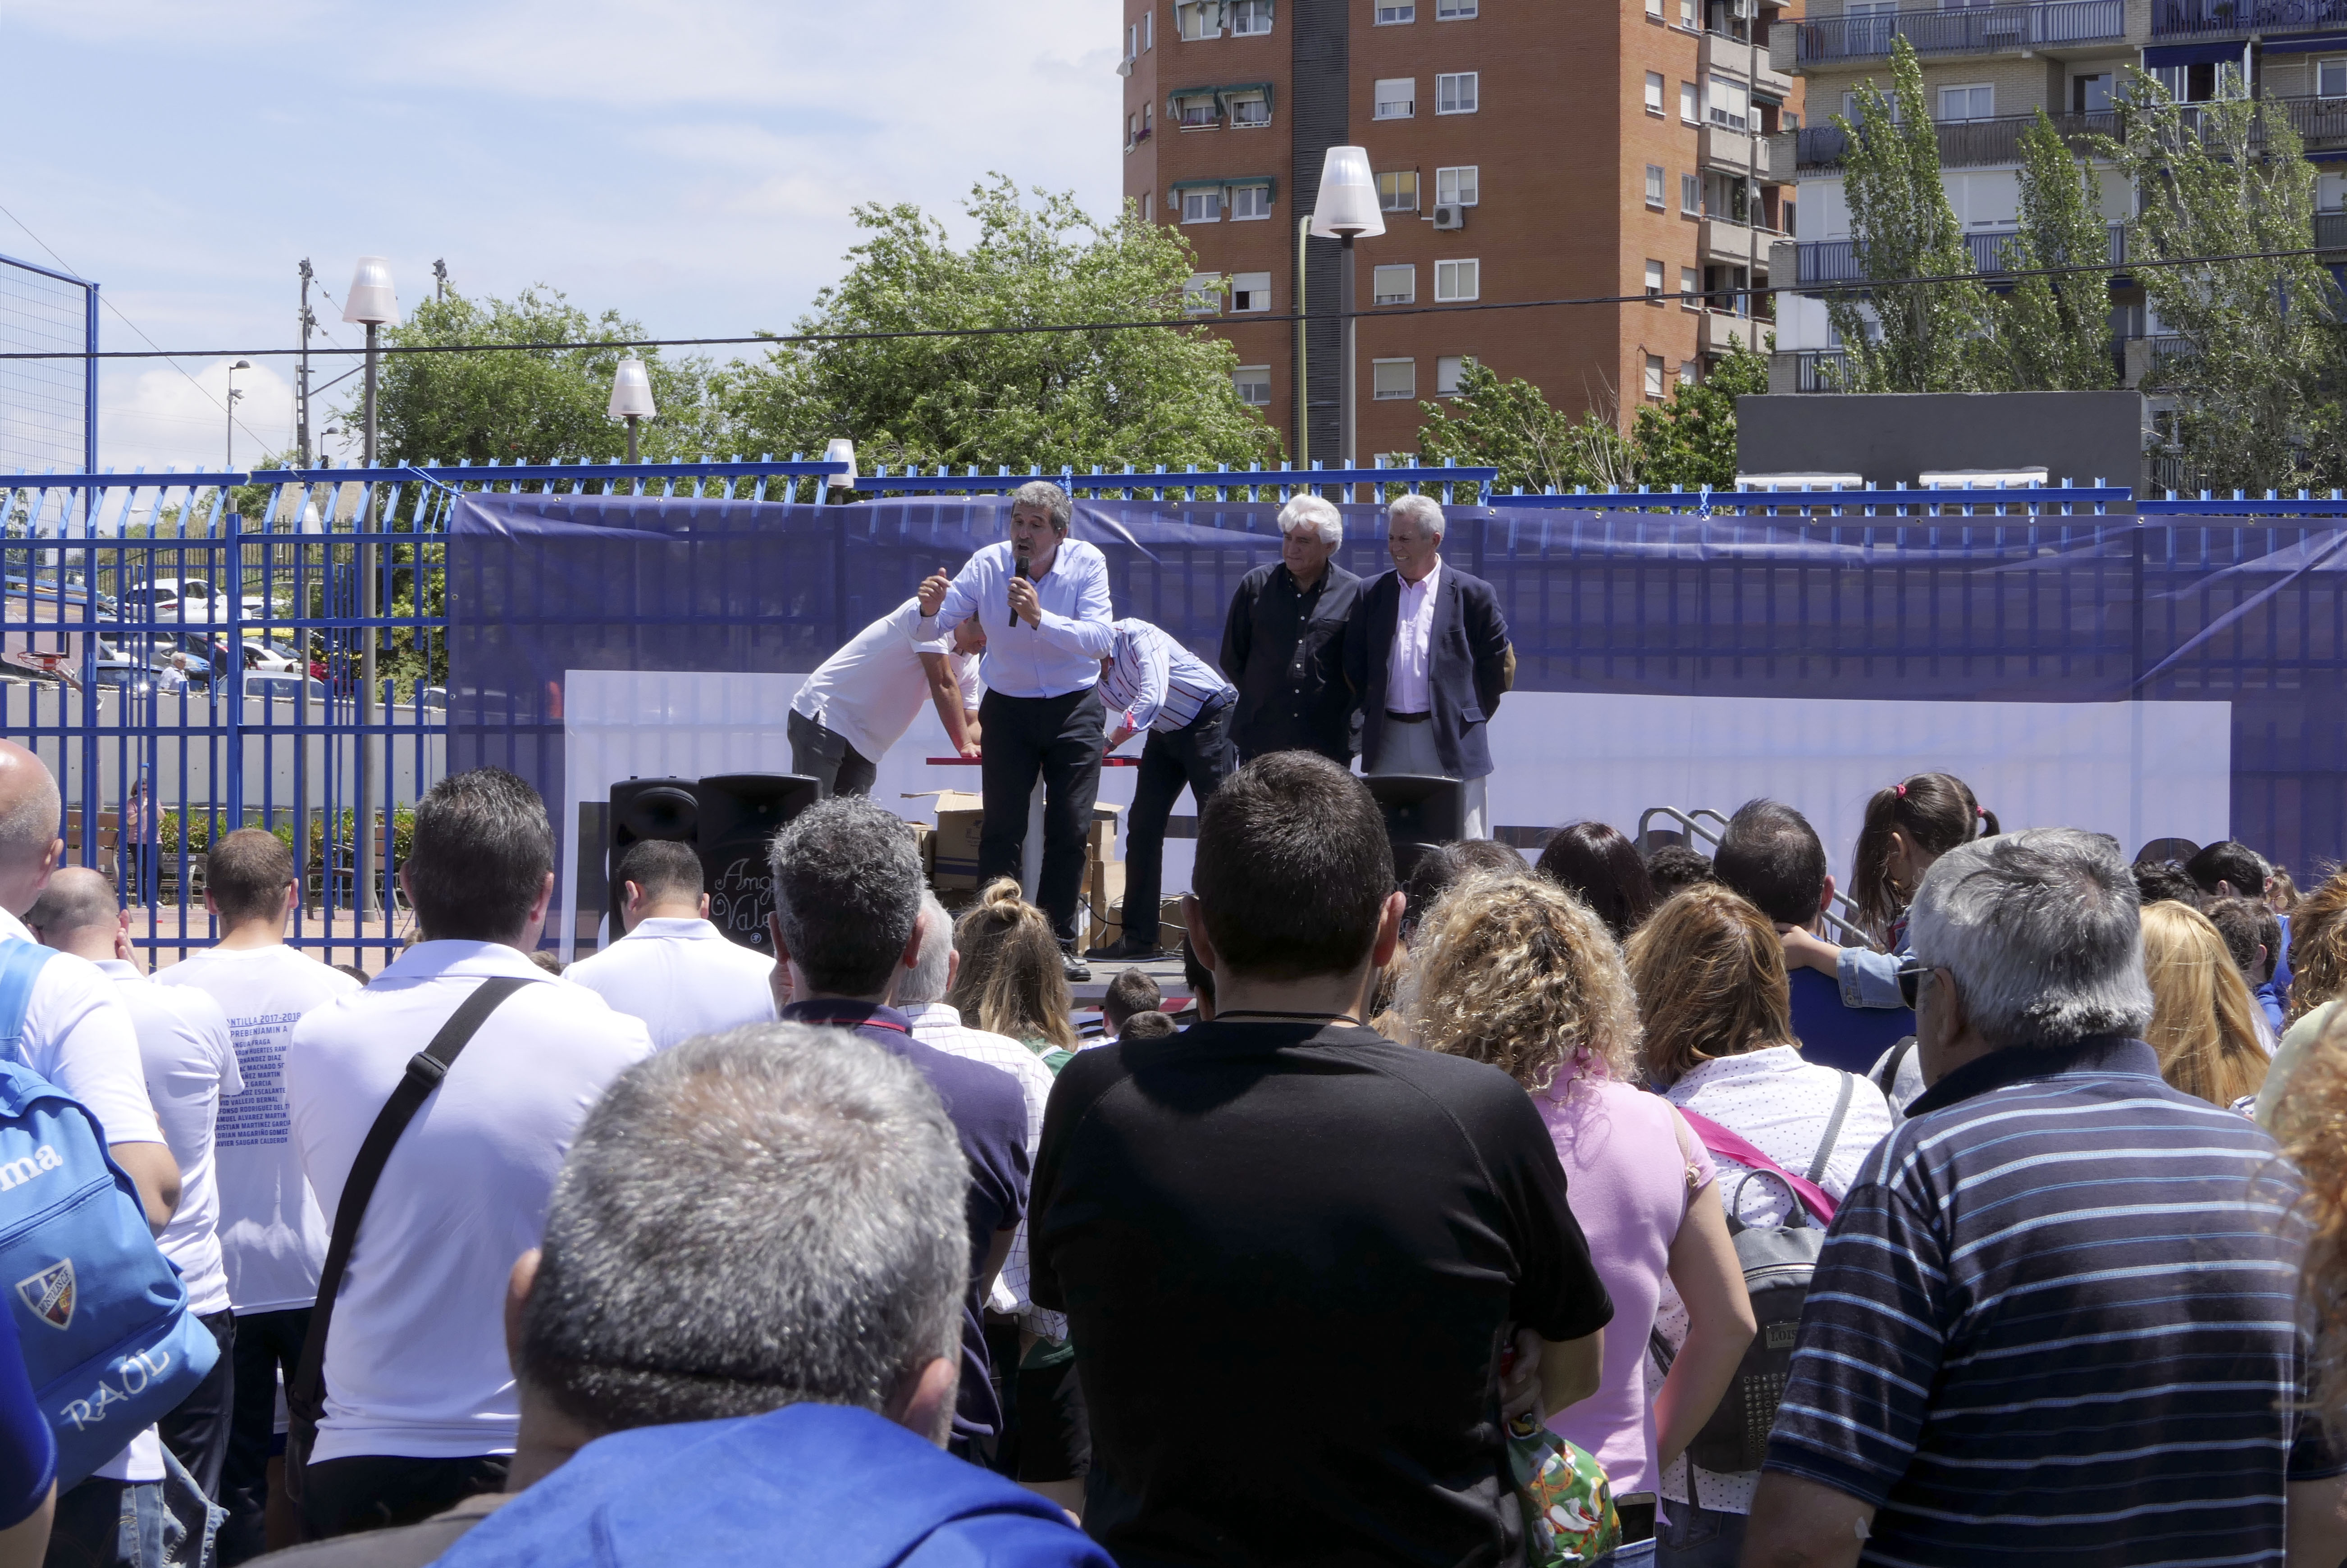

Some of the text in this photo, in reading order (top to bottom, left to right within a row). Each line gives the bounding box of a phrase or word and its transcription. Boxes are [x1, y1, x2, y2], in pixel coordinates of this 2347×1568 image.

[715, 858, 772, 906] Ang
[711, 893, 769, 931] Vale
[260, 1012, 301, 1023] 2017-2018
[230, 1026, 280, 1037] PREBENJAMIN
[237, 1056, 265, 1064] ERNANDEZ
[240, 1104, 272, 1113] RODRIGUEZ
[237, 1129, 269, 1137] MAGARIÑO
